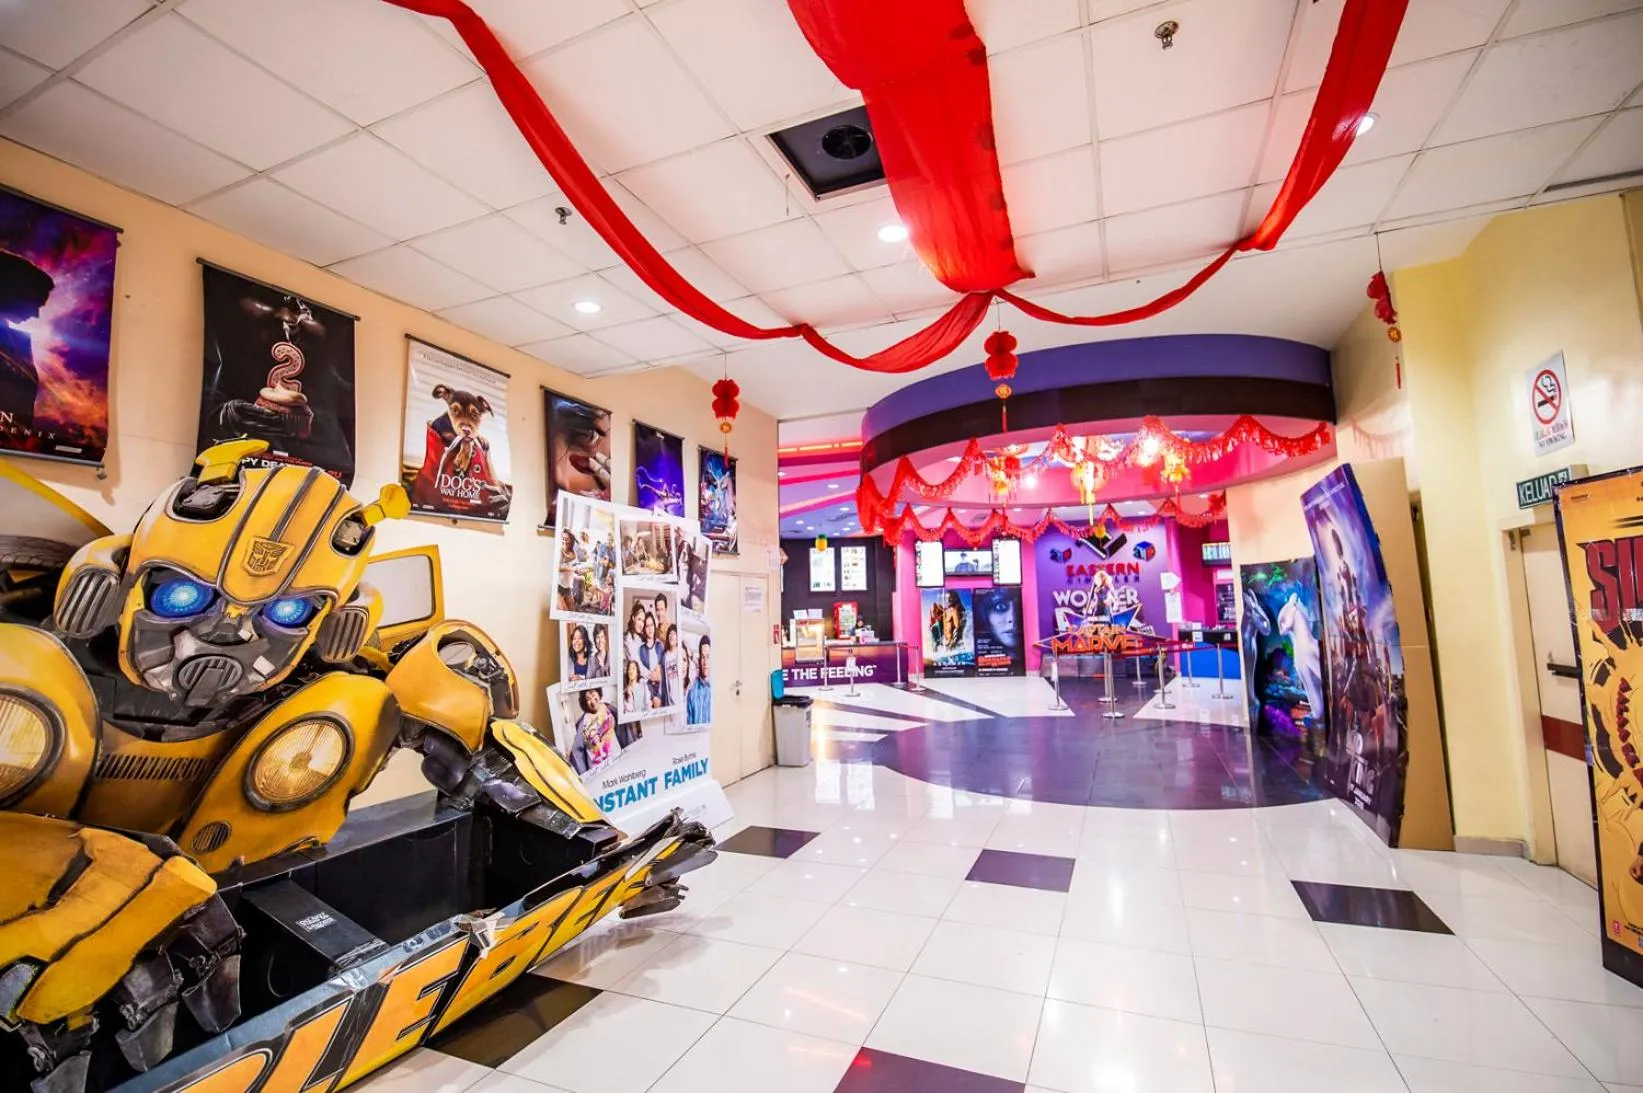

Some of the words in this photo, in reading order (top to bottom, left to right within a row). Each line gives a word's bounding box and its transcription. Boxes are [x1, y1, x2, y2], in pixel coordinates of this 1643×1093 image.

[440, 473, 481, 492] DOG'S
[457, 488, 480, 500] HOME
[1066, 562, 1140, 577] EASTERN
[791, 667, 818, 681] THE
[664, 758, 708, 790] FAMILY
